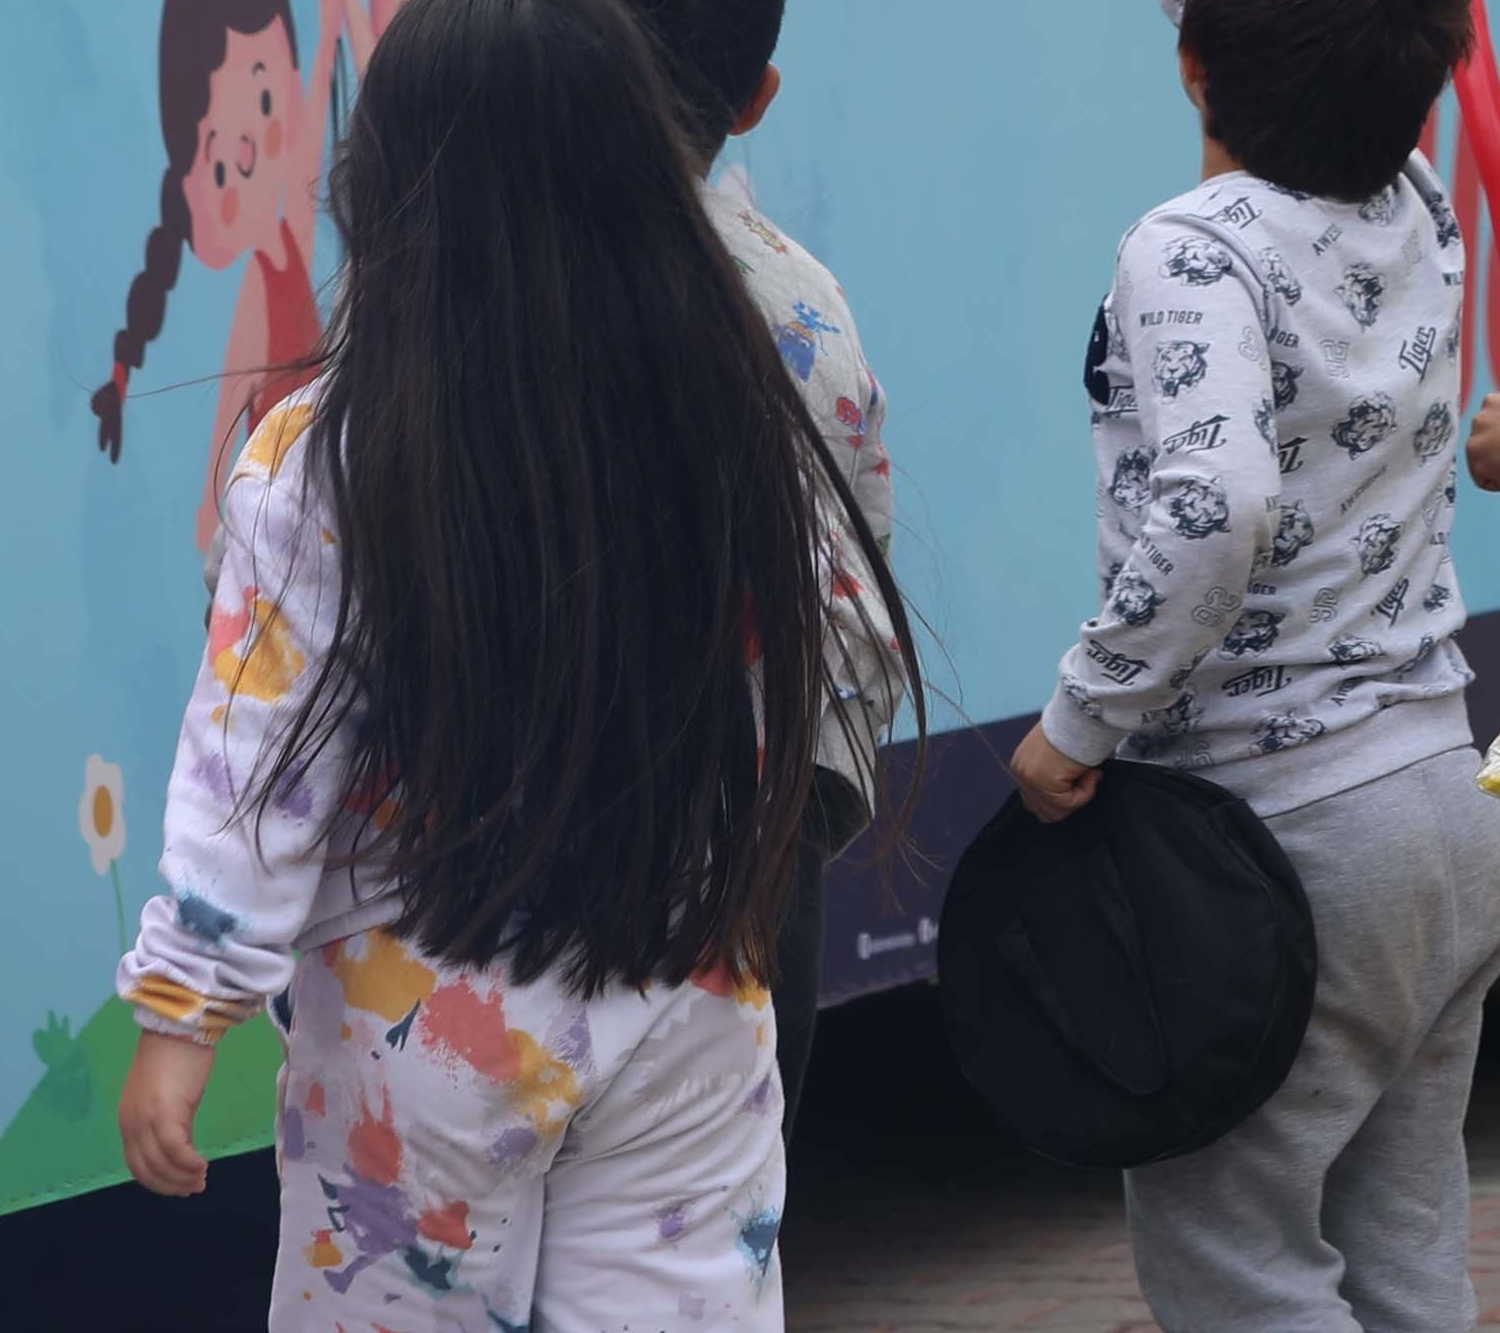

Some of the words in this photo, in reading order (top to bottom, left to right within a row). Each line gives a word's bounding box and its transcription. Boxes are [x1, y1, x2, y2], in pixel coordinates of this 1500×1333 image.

[1139, 311, 1166, 329] WILD
[1167, 309, 1203, 326] TIGER
[1400, 325, 1437, 384] Tiger
[1160, 413, 1233, 455] Tiger
[1147, 543, 1175, 577] TIGER
[1084, 639, 1151, 687] Tiger
[1220, 664, 1293, 699] Tiger
